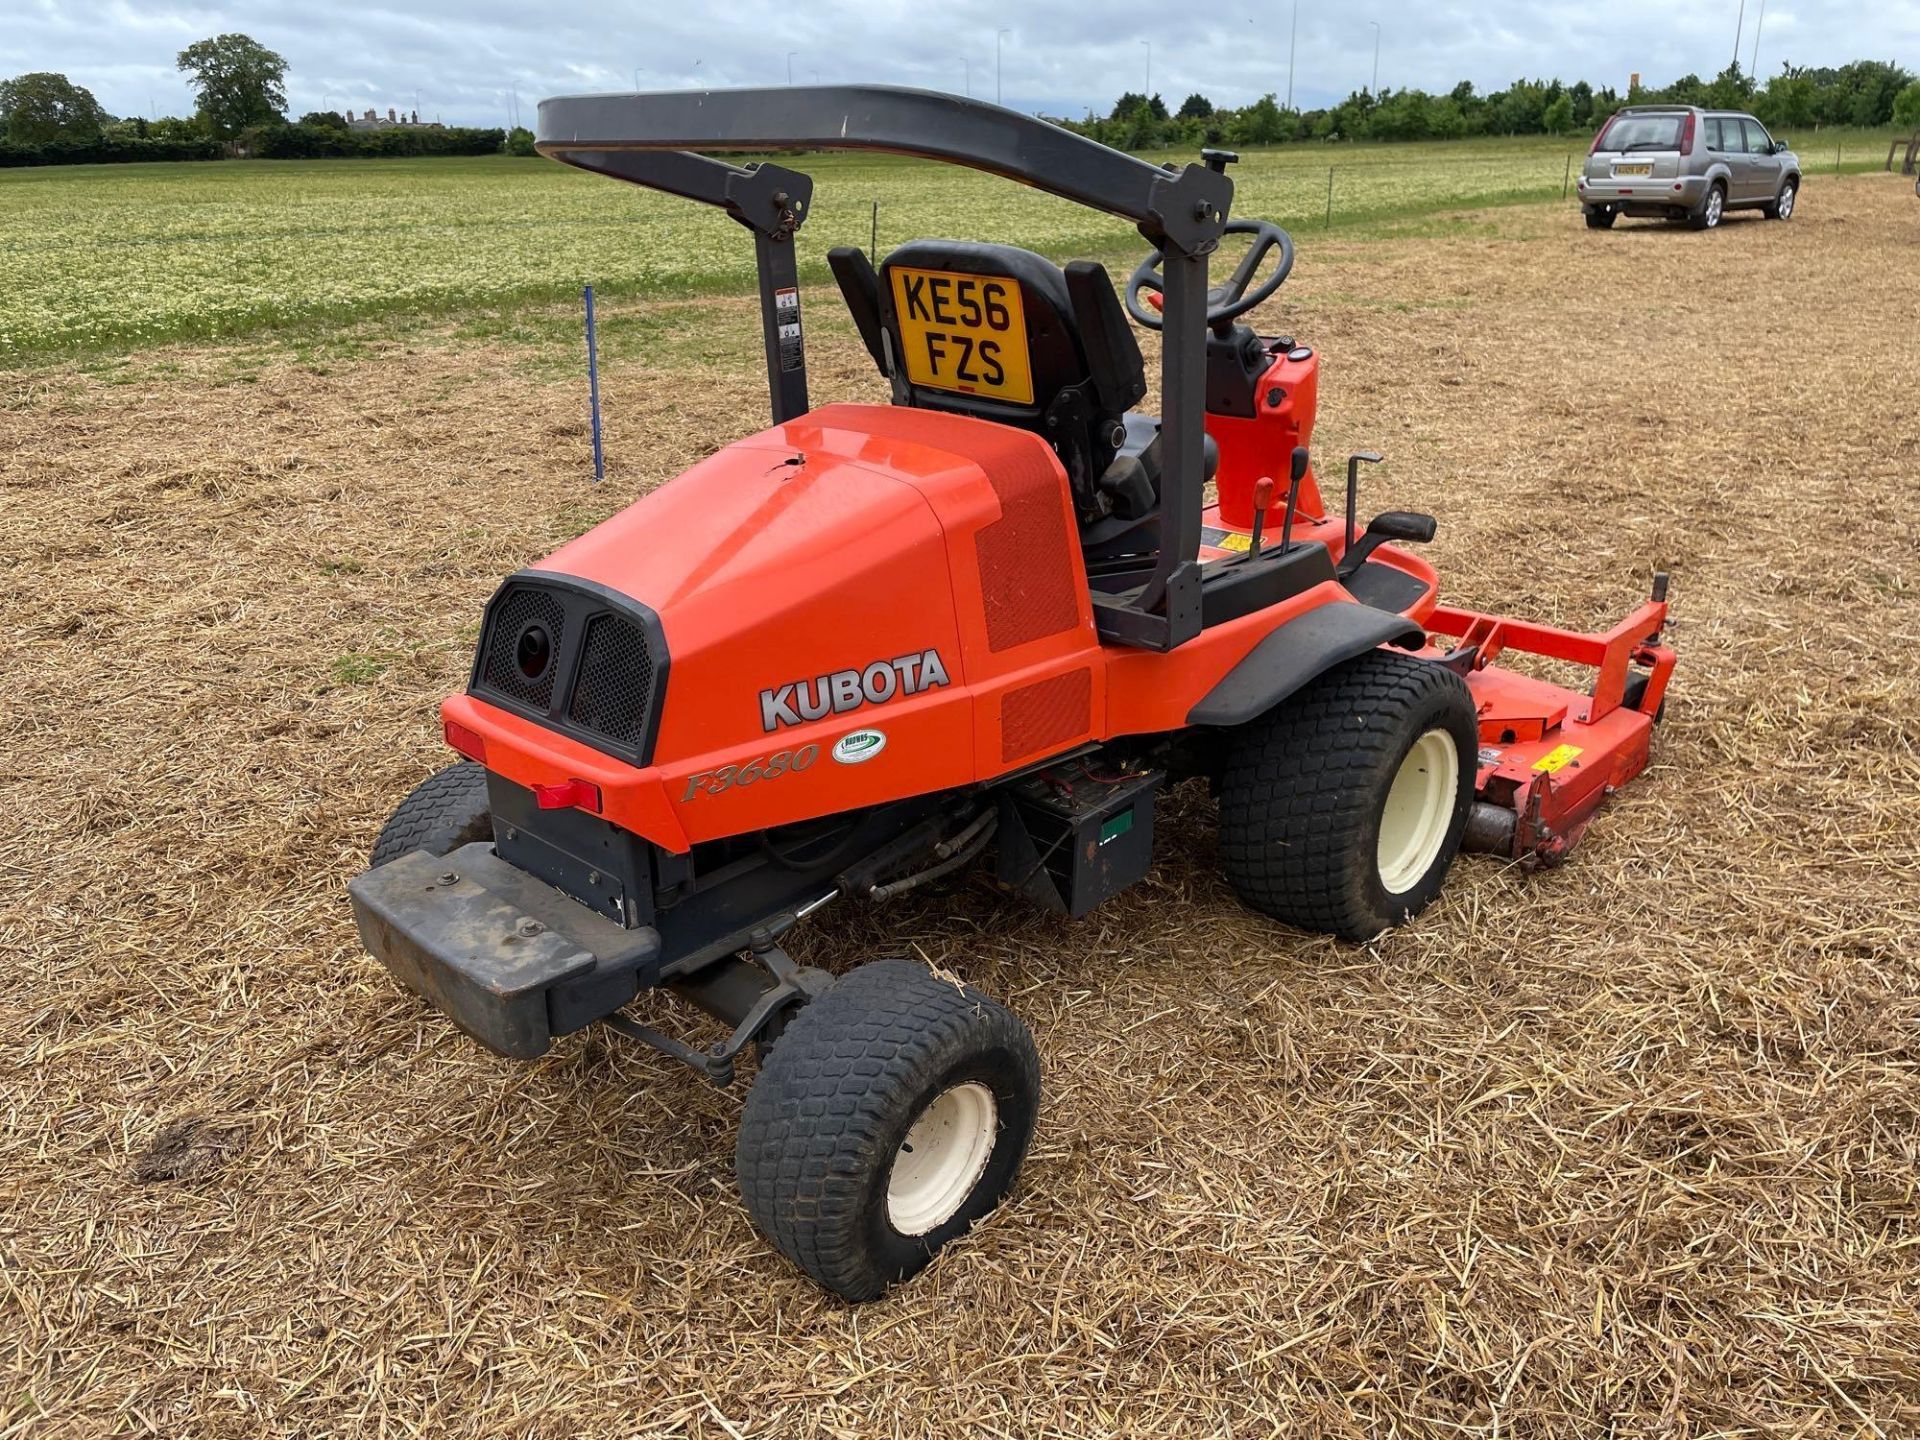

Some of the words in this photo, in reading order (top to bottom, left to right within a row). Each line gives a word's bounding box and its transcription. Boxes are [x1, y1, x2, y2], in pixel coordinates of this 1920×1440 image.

[903, 275, 1010, 331] KE56
[925, 331, 1005, 386] FZS
[759, 648, 951, 733] KUBOTA
[681, 744, 820, 803] F3680
